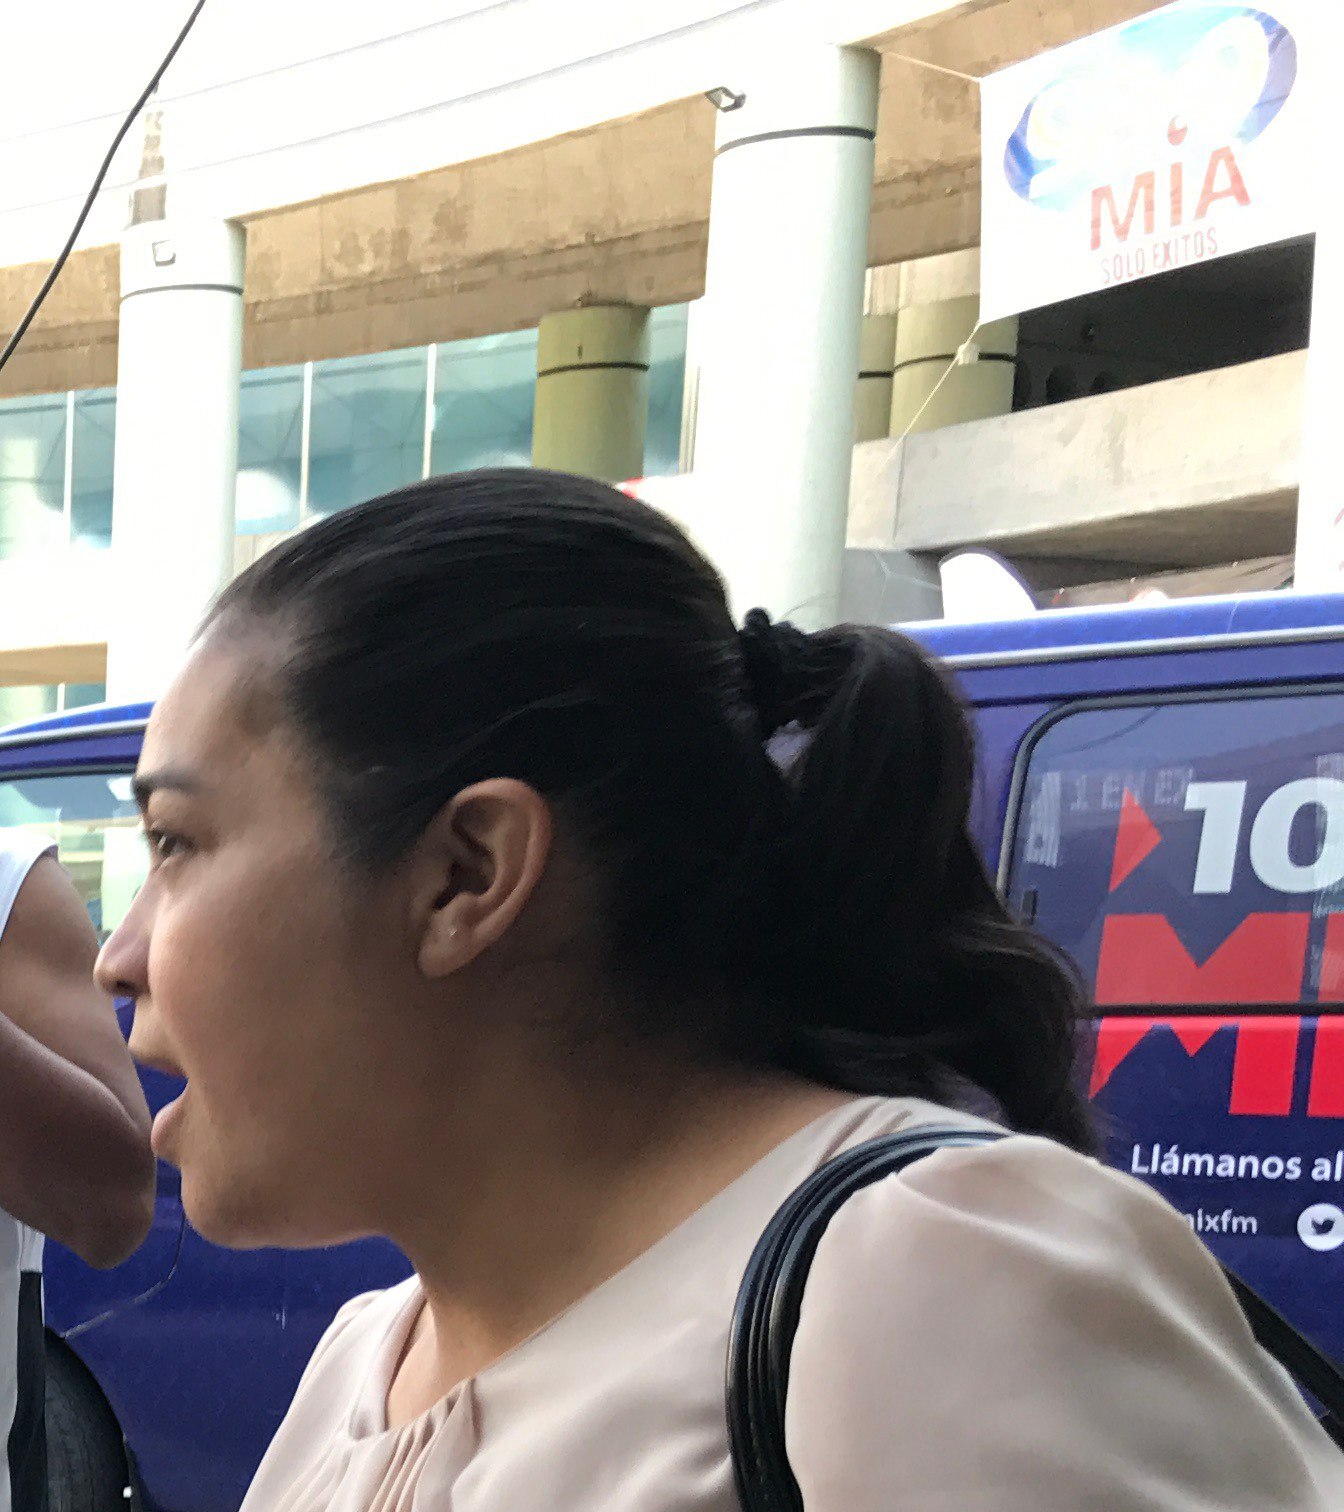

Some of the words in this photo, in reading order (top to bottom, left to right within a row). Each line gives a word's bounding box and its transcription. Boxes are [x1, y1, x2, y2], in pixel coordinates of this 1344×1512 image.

[1100, 247, 1146, 285] SOLO
[1152, 226, 1218, 269] EXITOS
[1130, 1142, 1302, 1180] Llámanos
[1311, 1149, 1344, 1182] al
